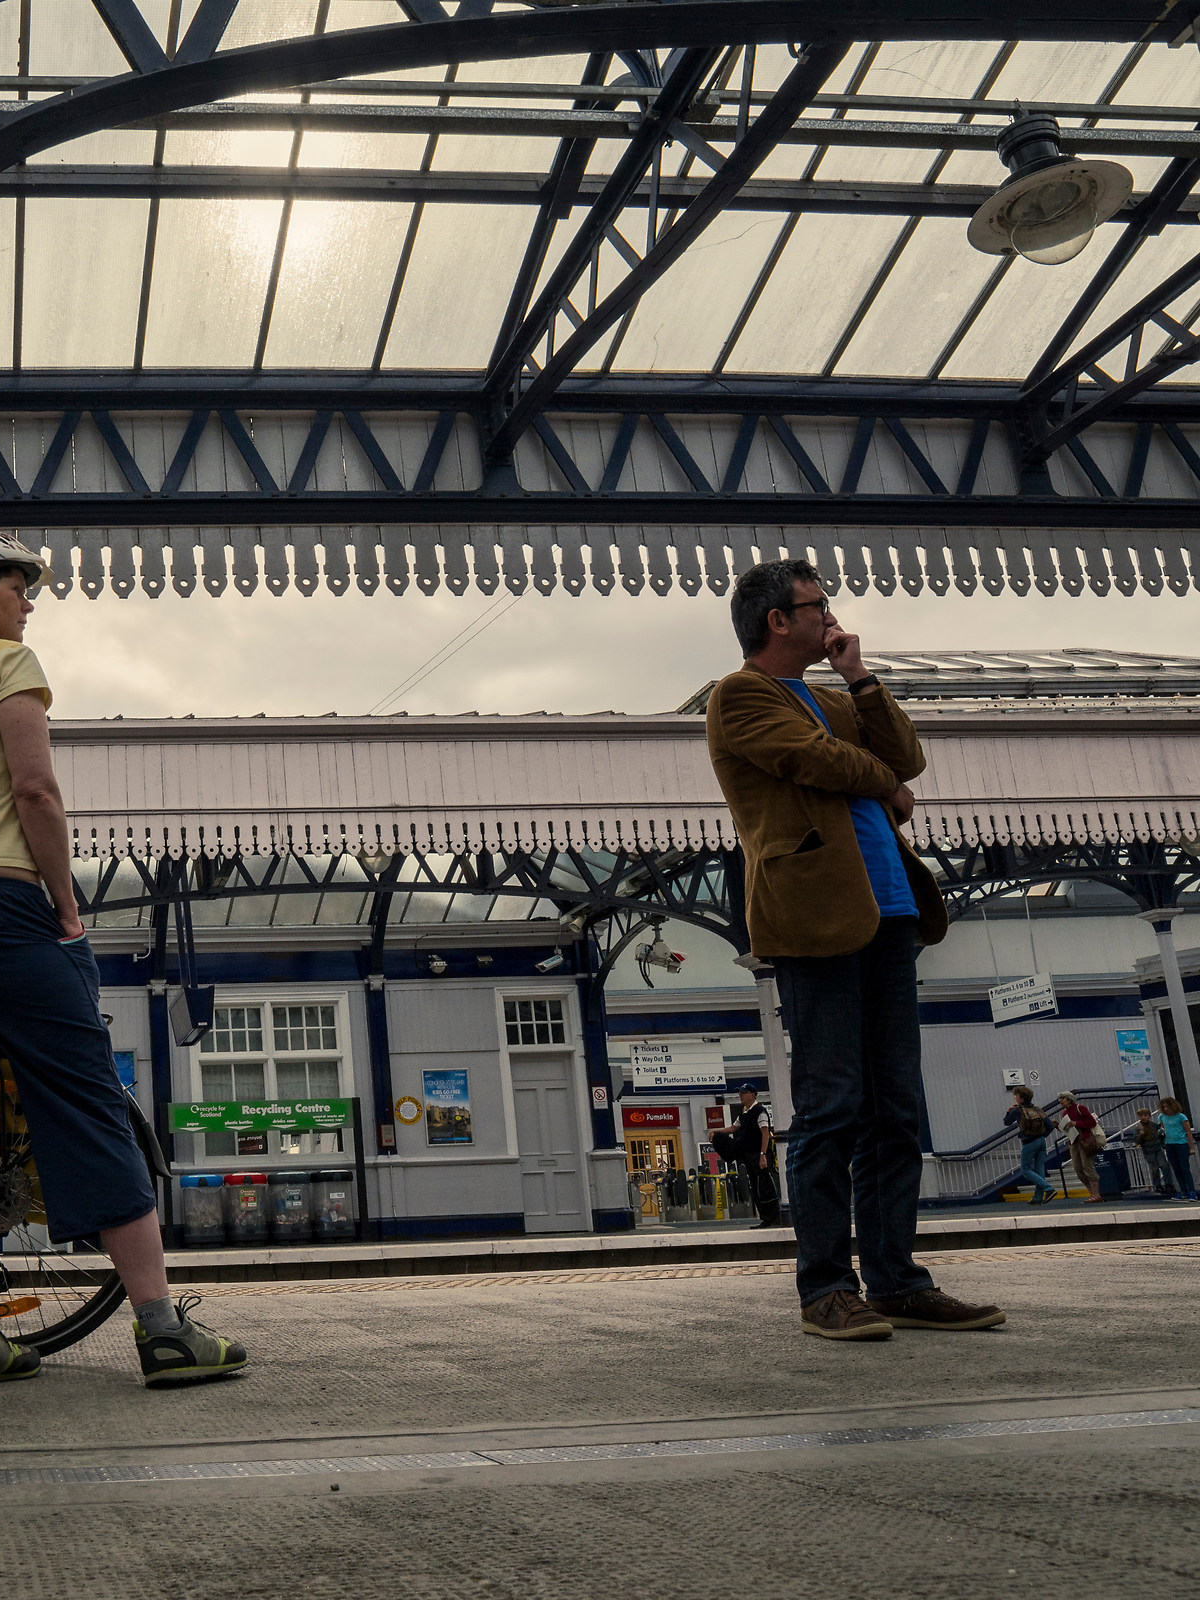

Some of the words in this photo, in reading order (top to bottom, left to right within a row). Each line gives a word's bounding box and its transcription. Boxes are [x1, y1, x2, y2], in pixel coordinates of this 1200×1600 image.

[994, 987, 1011, 996] Platforms
[1008, 995, 1023, 1004] Platform
[1040, 1000, 1048, 1008] Lift
[241, 1104, 292, 1116] Recycling
[294, 1103, 331, 1113] Centre
[645, 1113, 674, 1121] Pumpkin
